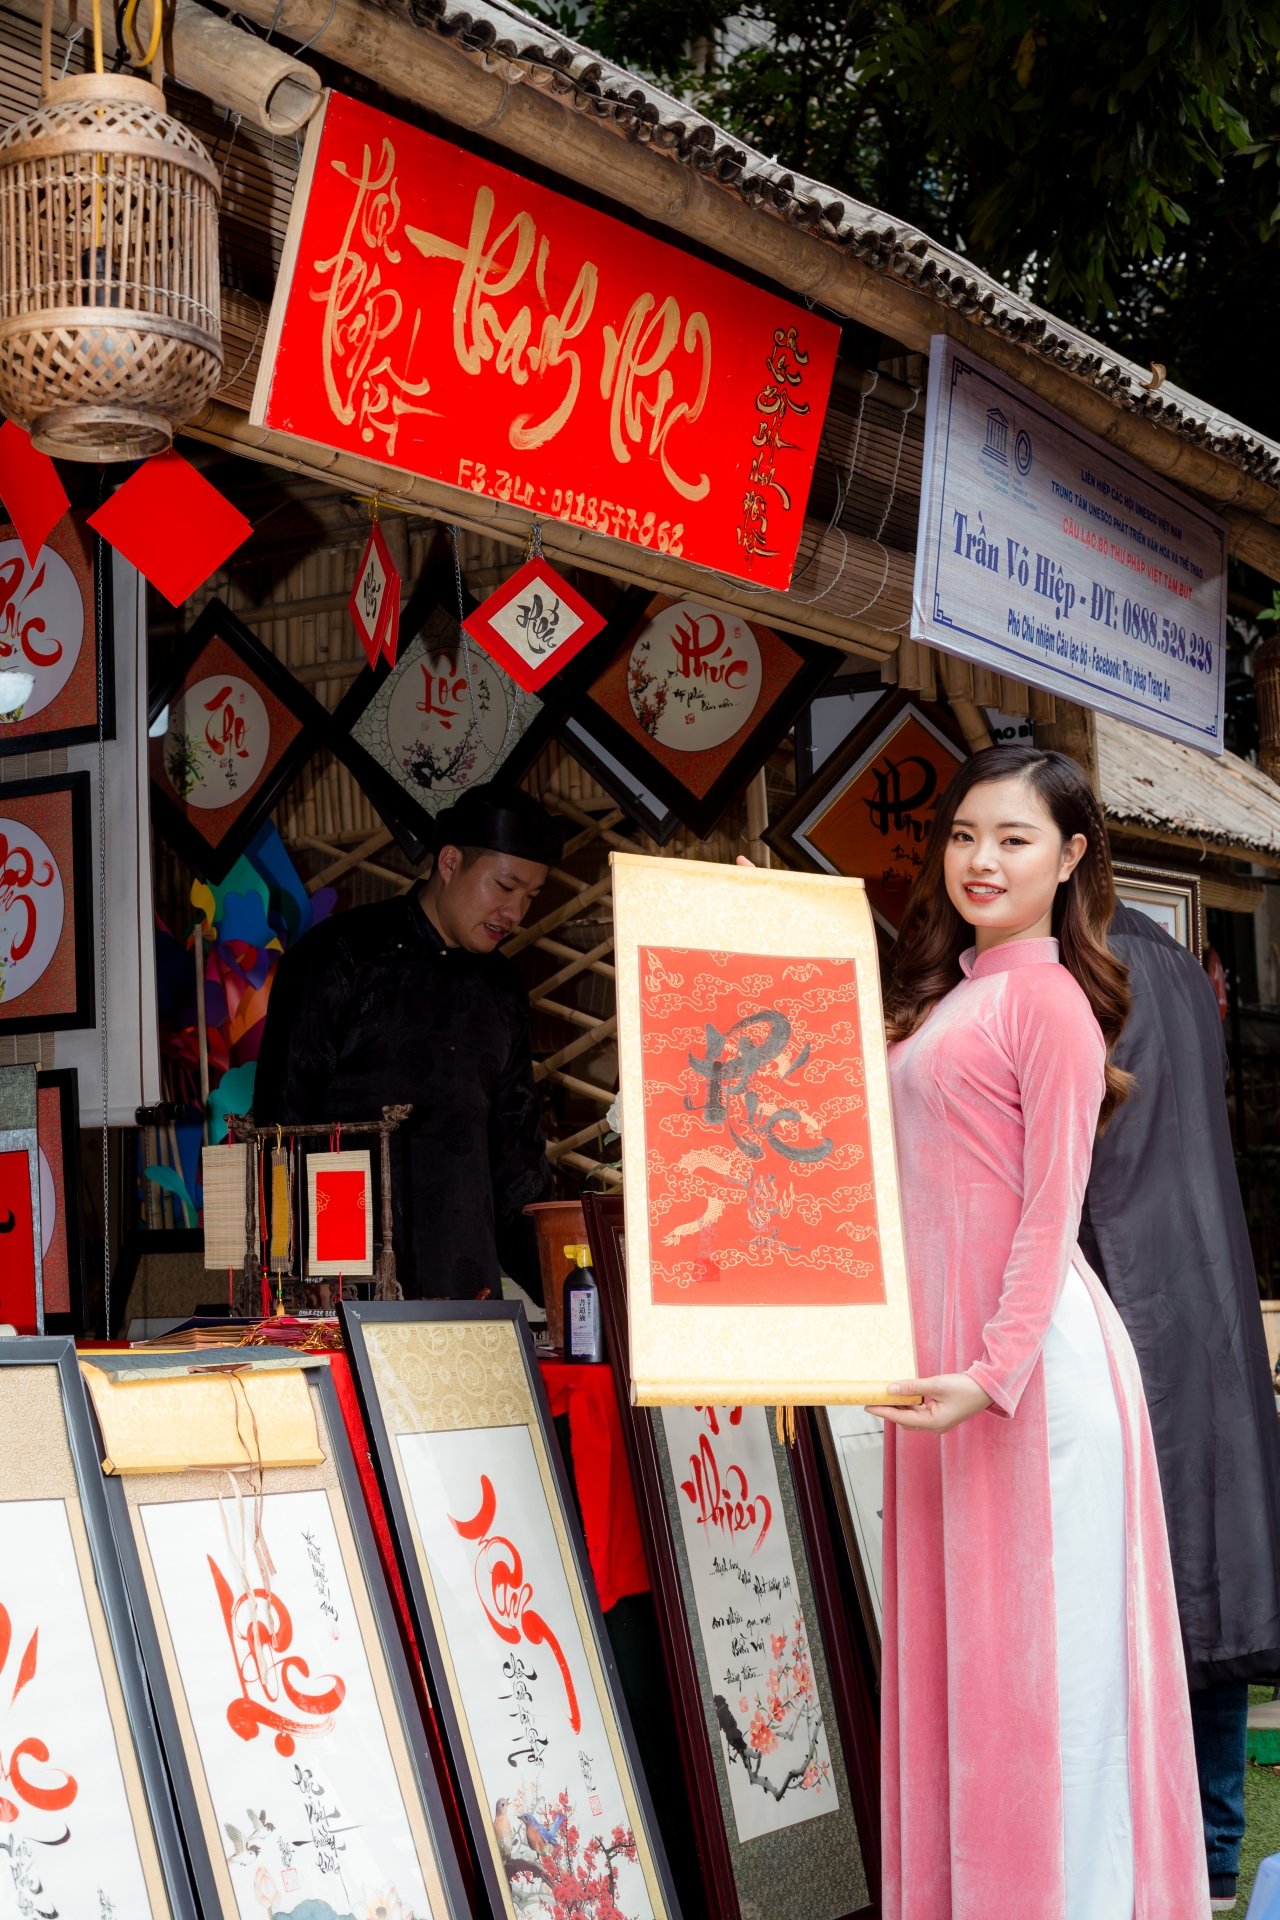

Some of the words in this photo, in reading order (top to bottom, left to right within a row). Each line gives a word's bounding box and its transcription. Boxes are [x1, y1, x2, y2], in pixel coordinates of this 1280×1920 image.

[1051, 480, 1073, 503] TRUNG
[1074, 492, 1088, 513] TÂM
[1088, 503, 1112, 526] UNESCO
[1113, 516, 1129, 537] PHÁT
[1129, 527, 1146, 545] TRIỂN
[1081, 468, 1096, 487] LIÊN
[1096, 479, 1111, 498] HIỆP
[1135, 505, 1157, 525] UNESCO
[1157, 516, 1170, 535] VIỆT
[1171, 525, 1183, 540] NAM
[953, 507, 999, 574] Trần
[1007, 537, 1029, 587] Võ
[1034, 552, 1075, 620] Hiệp
[1090, 581, 1118, 631] ĐT:
[1122, 598, 1213, 675] 0888.528.228
[1062, 516, 1080, 540] CÂU
[1082, 528, 1097, 550] LẠC
[1098, 537, 1109, 560] BỘ
[1127, 553, 1146, 575] PHÁP
[1147, 563, 1163, 588] VIỆT
[1164, 574, 1179, 595] TÂM
[1179, 582, 1193, 600] BÚT
[669, 611, 750, 689] Phúc
[1007, 608, 1020, 637] Phó
[1036, 622, 1055, 657] nhiệm
[1133, 665, 1146, 695] pháp
[203, 686, 250, 758] Thọ
[416, 651, 467, 730] Lộc
